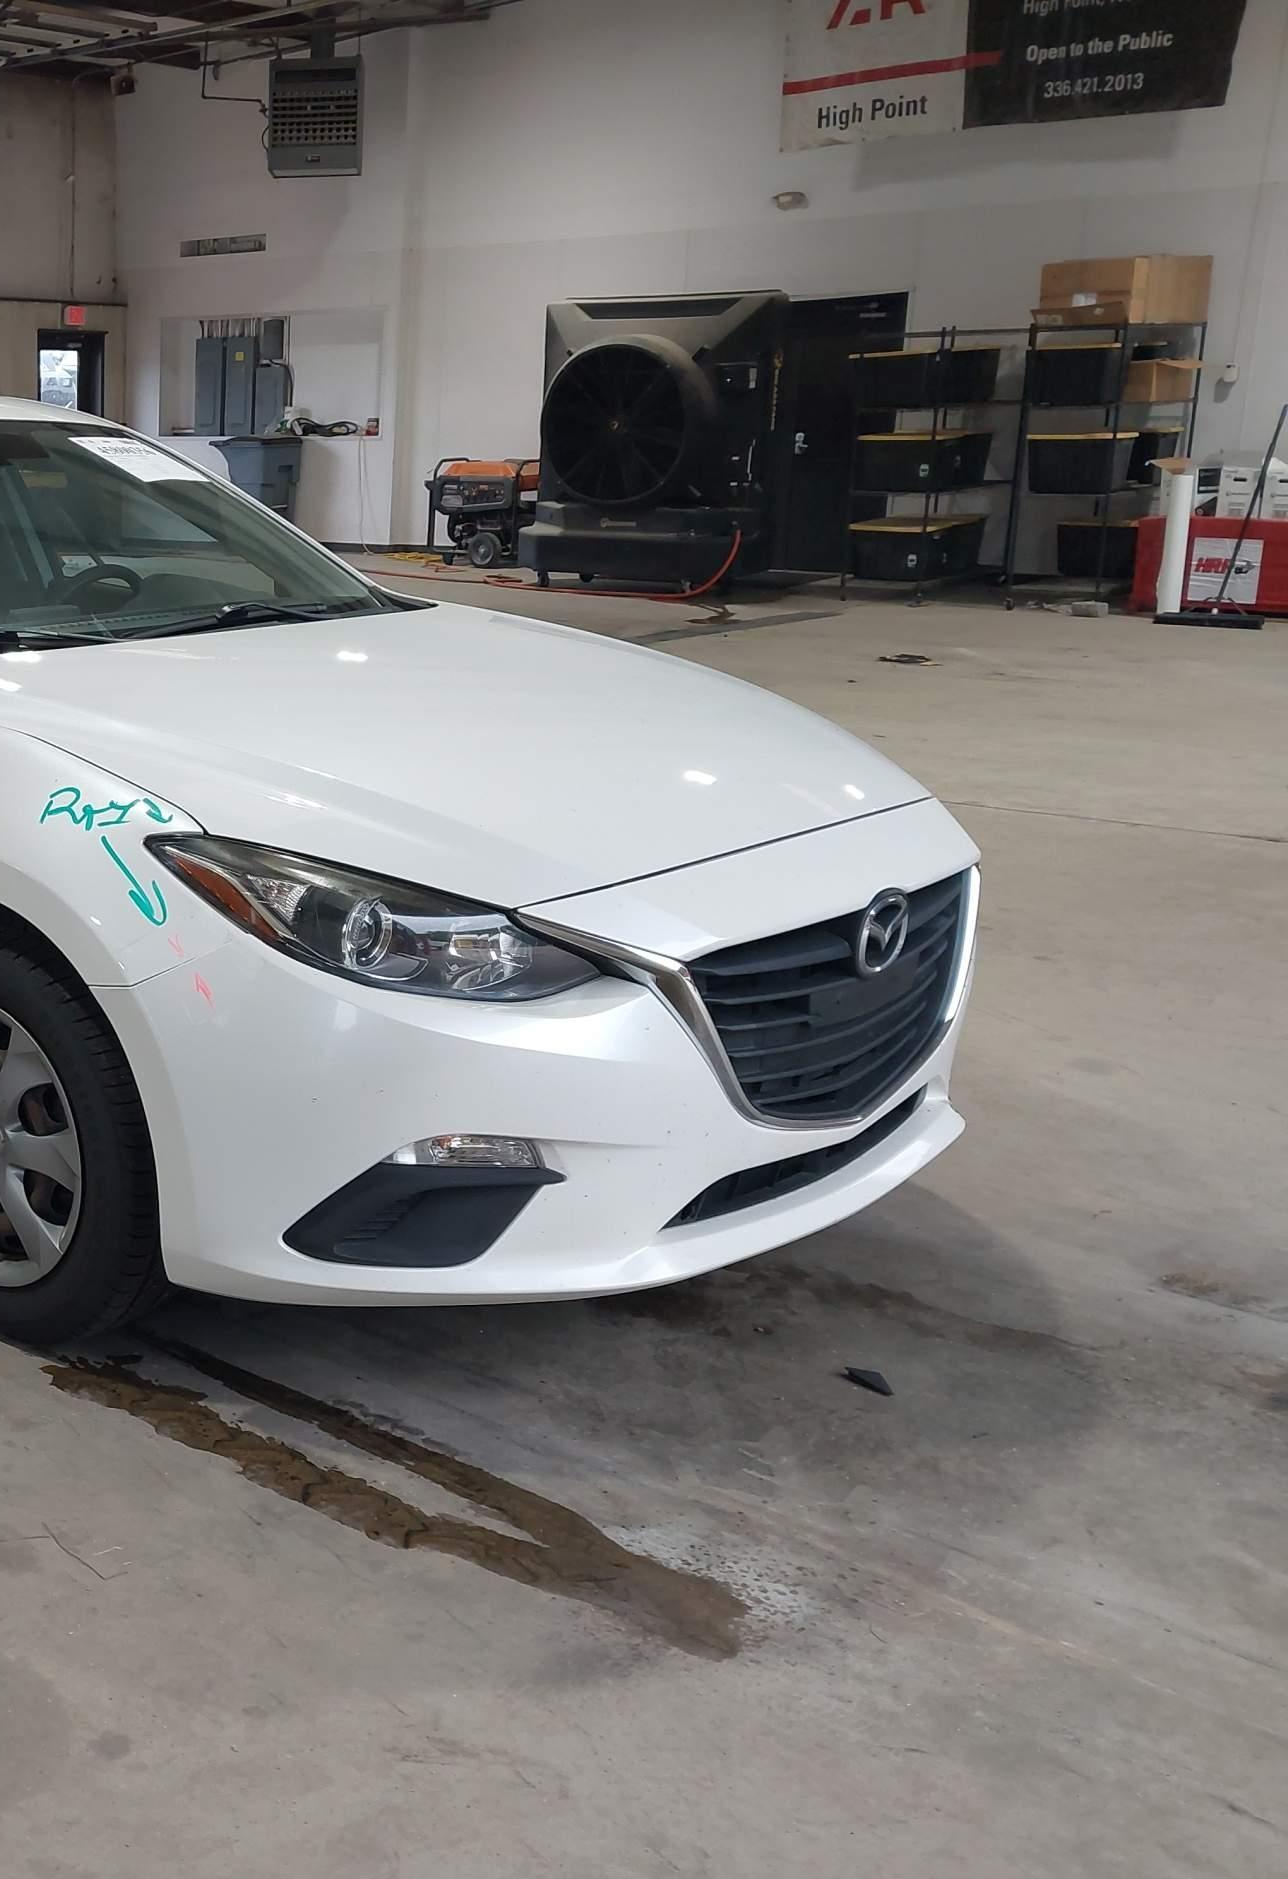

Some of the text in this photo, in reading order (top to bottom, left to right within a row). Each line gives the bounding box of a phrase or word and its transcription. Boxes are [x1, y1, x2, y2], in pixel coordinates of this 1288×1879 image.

[1026, 30, 1174, 65] Open to the Public
[1043, 72, 1145, 98] 336.421.2013
[817, 95, 929, 130] High Point
